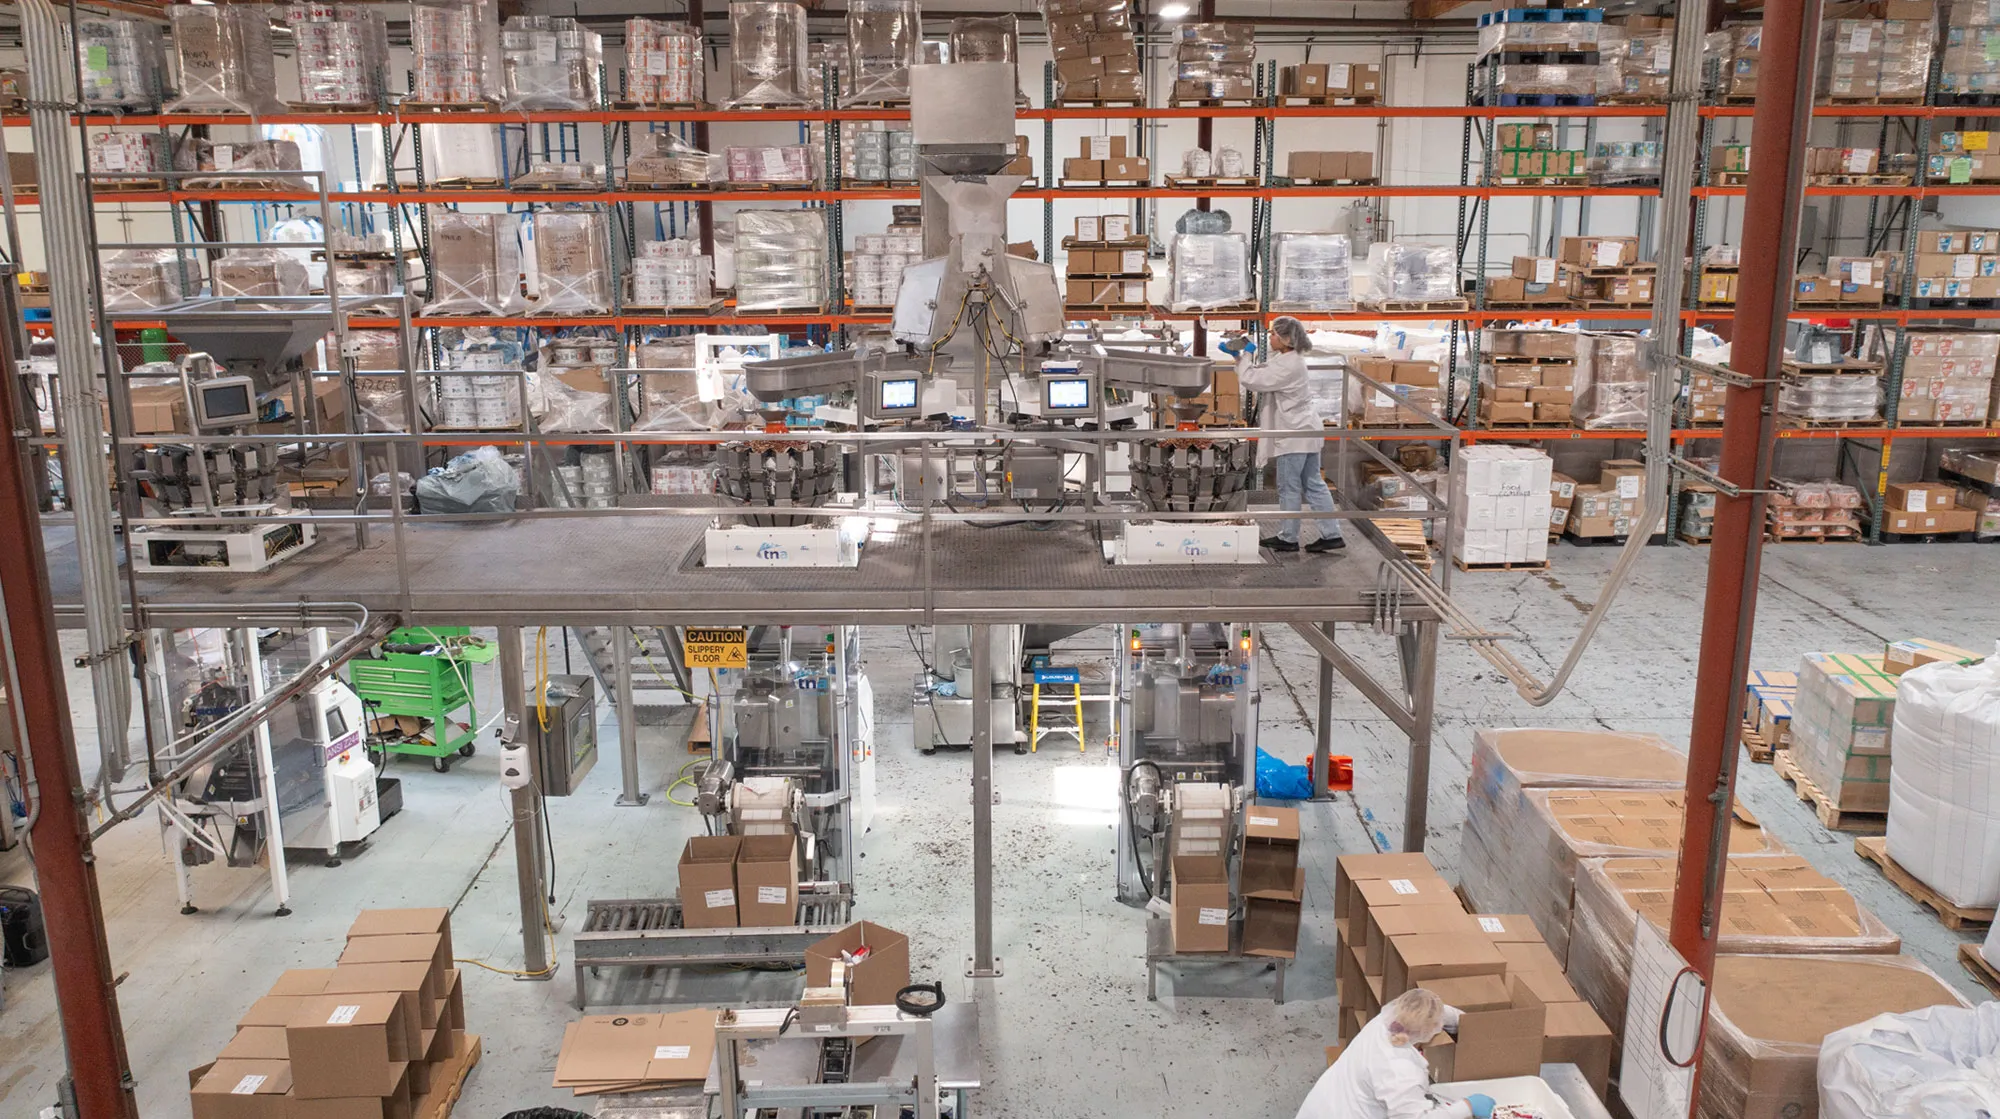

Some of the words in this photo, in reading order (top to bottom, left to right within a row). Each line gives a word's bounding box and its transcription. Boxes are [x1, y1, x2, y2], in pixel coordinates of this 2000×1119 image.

[763, 550, 788, 560] tna
[1185, 546, 1208, 556] tna
[687, 631, 743, 642] CAUTION
[688, 645, 725, 654] SLIPPERY
[693, 655, 721, 663] FLOOR
[798, 678, 828, 689] tna
[1214, 674, 1245, 685] tna
